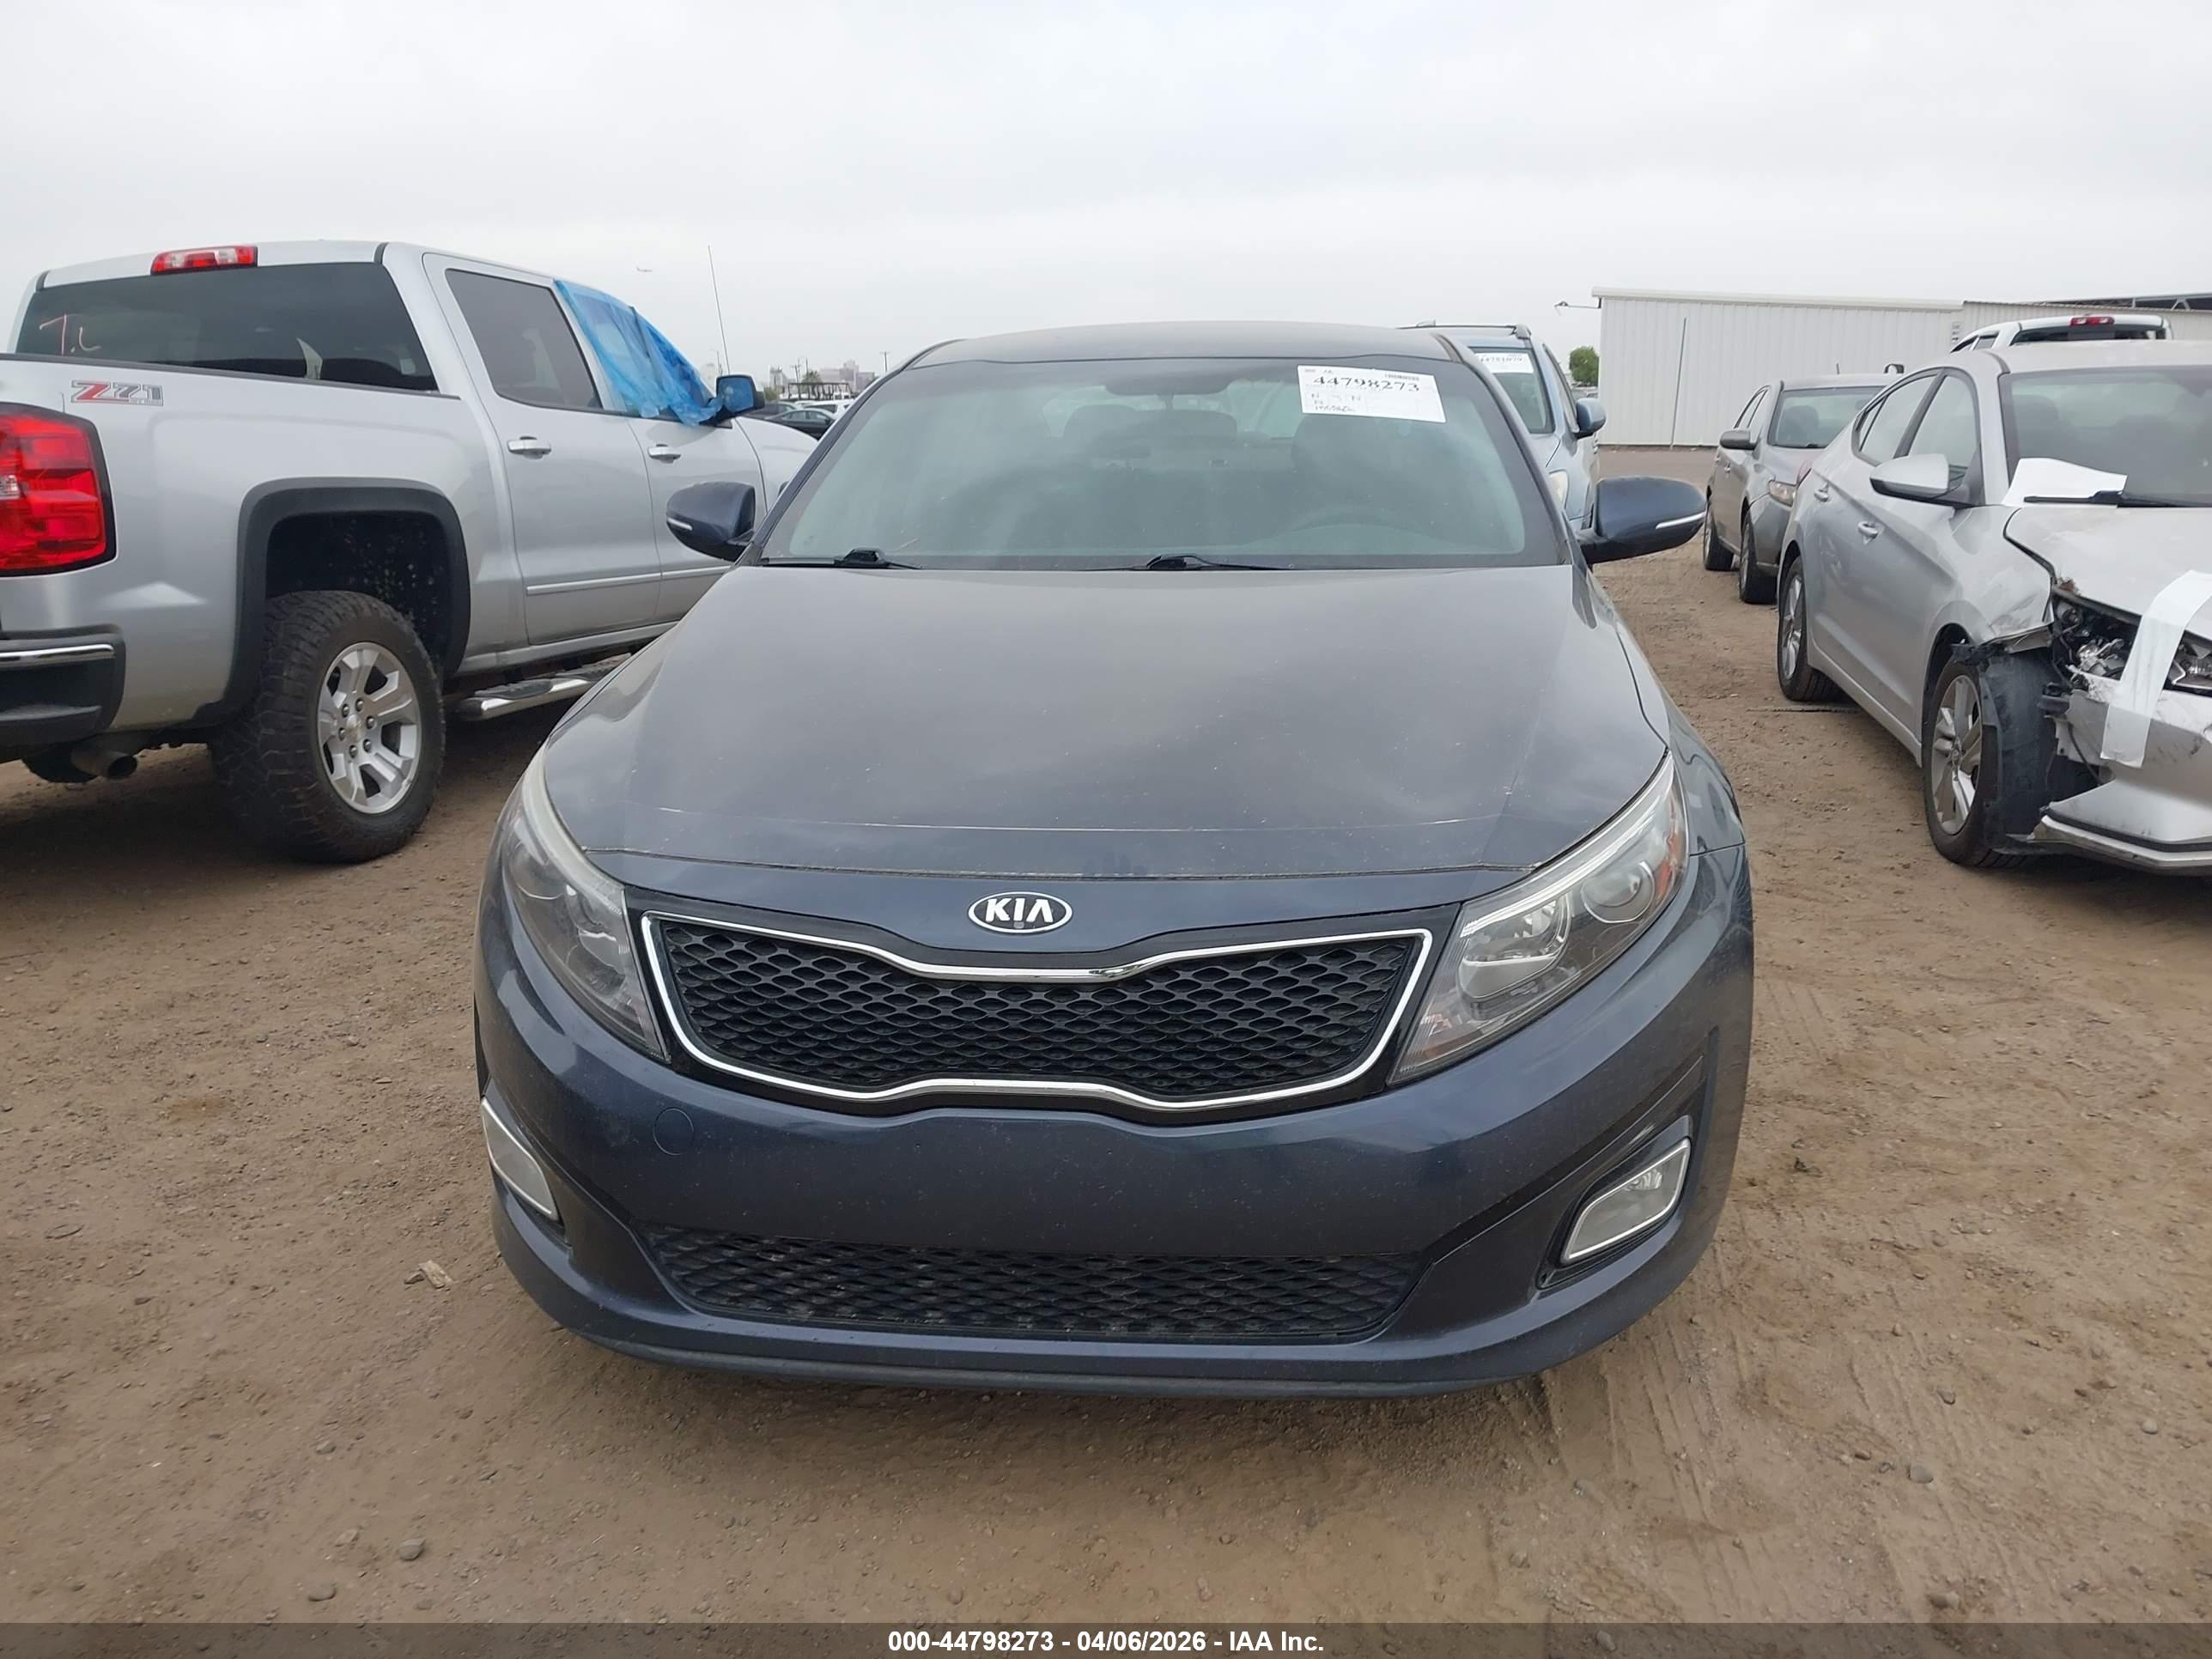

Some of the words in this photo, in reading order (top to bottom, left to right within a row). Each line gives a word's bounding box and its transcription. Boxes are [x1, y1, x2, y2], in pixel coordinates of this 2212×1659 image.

[71, 380, 163, 405] Z71
[1313, 375, 1419, 392] 44798273
[985, 897, 1054, 923] KIA
